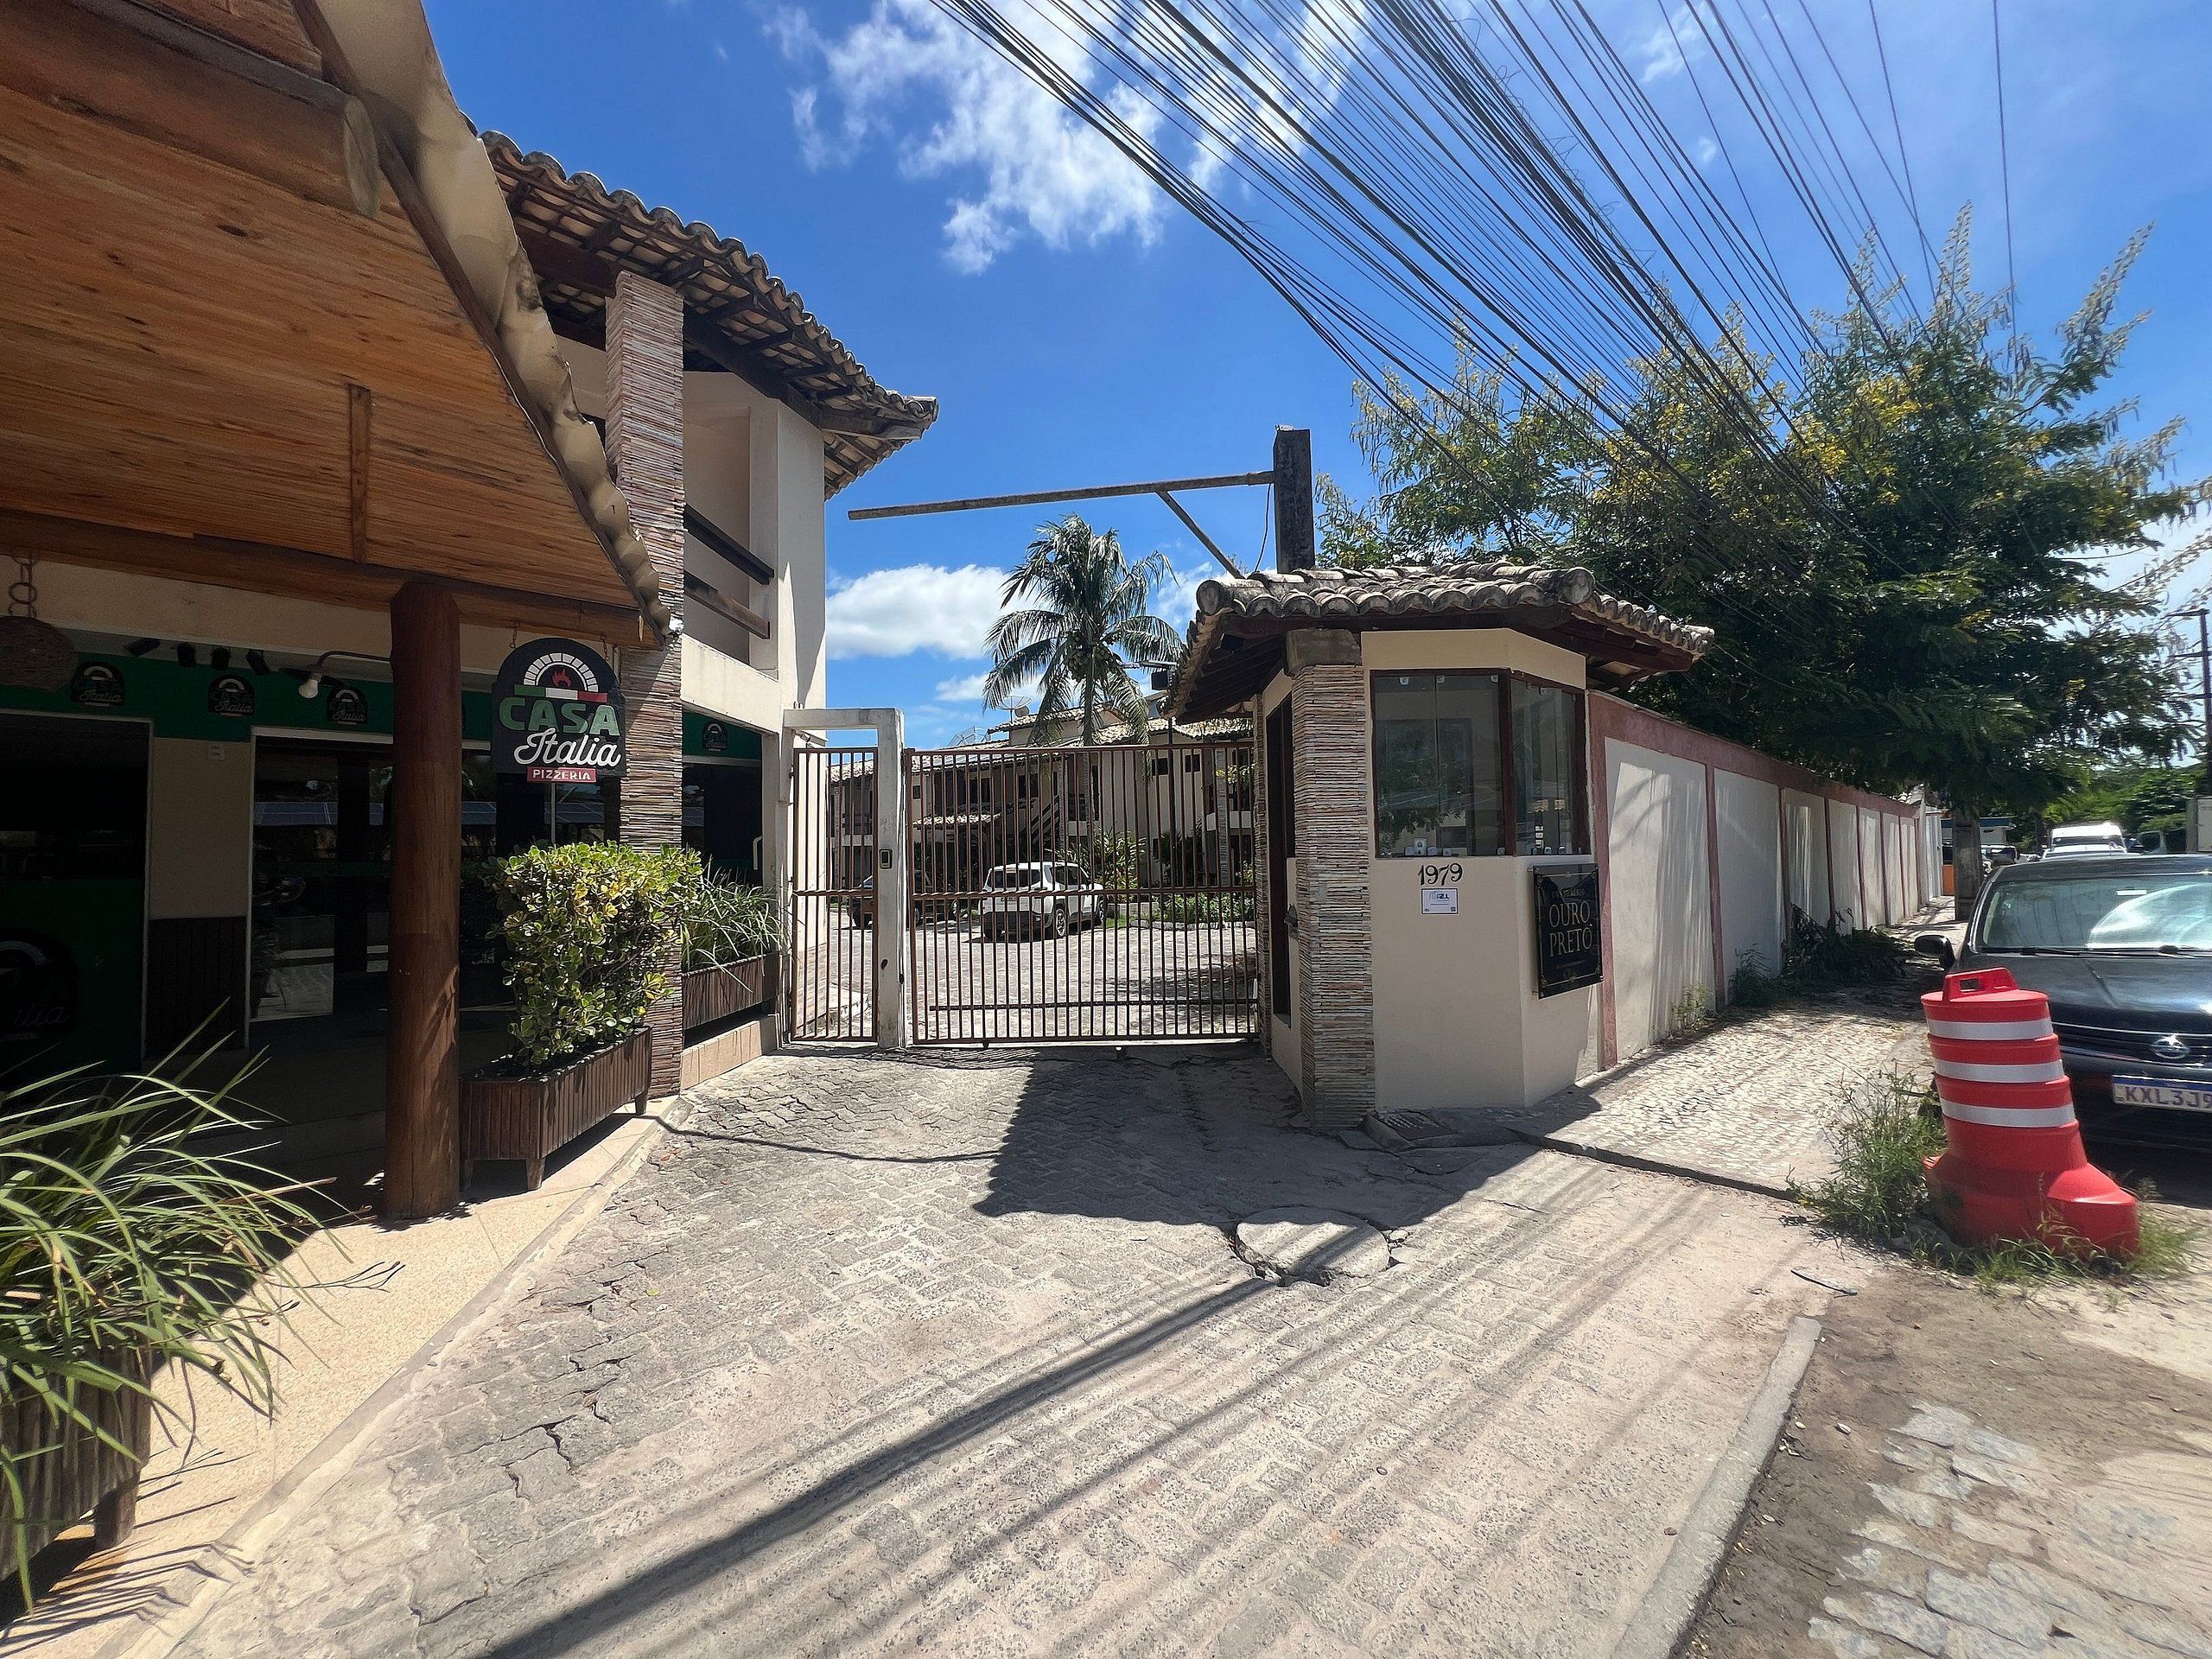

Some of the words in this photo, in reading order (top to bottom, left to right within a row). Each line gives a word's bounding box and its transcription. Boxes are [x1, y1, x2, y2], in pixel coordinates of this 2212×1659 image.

[499, 696, 620, 736] CASA
[514, 728, 622, 767] Italia
[532, 769, 592, 780] PIZZERIA
[1418, 862, 1463, 887] 1979
[1548, 900, 1591, 928] OURO
[1549, 927, 1592, 957] PRETO
